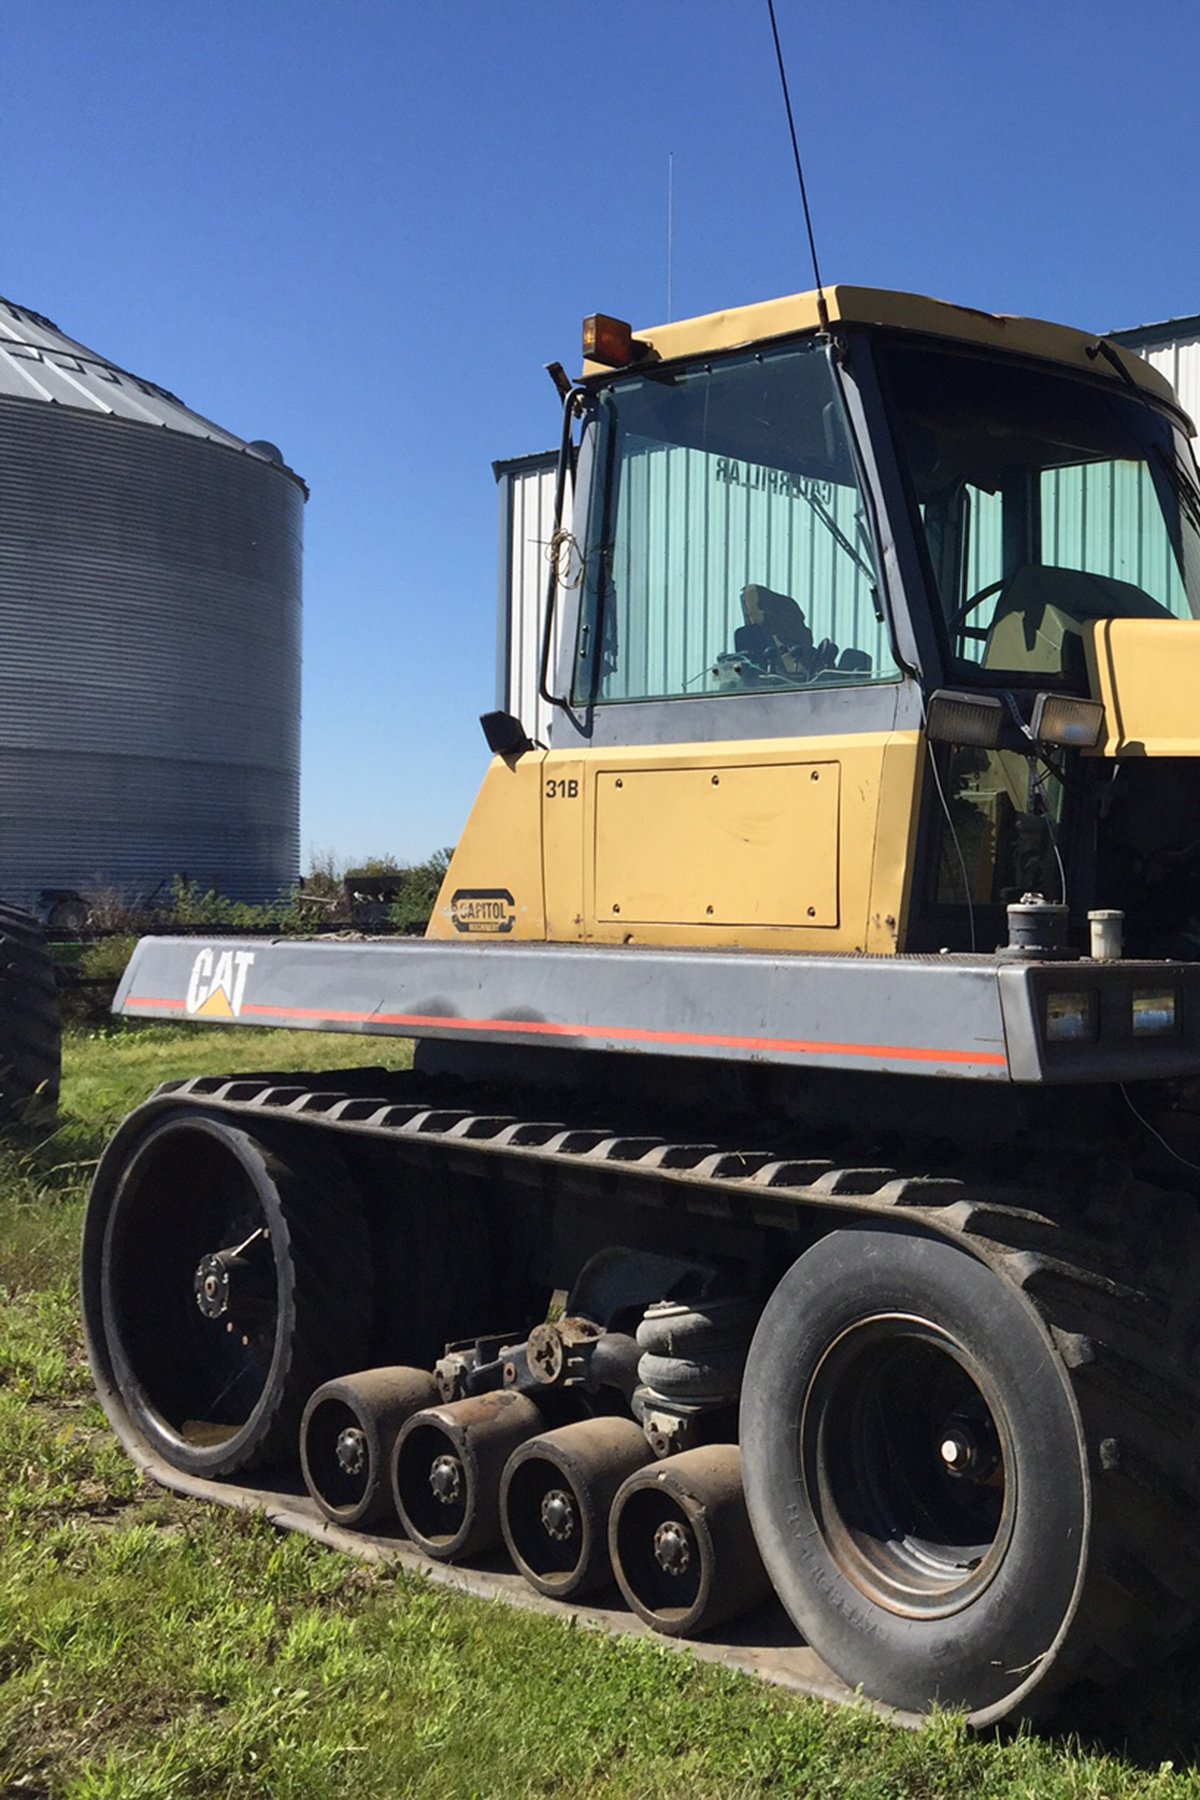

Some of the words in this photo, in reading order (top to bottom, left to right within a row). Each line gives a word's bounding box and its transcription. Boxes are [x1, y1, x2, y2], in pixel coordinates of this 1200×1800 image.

[545, 779, 579, 798] 31B
[459, 902, 507, 919] CAPITOL
[186, 947, 255, 1017] CAT
